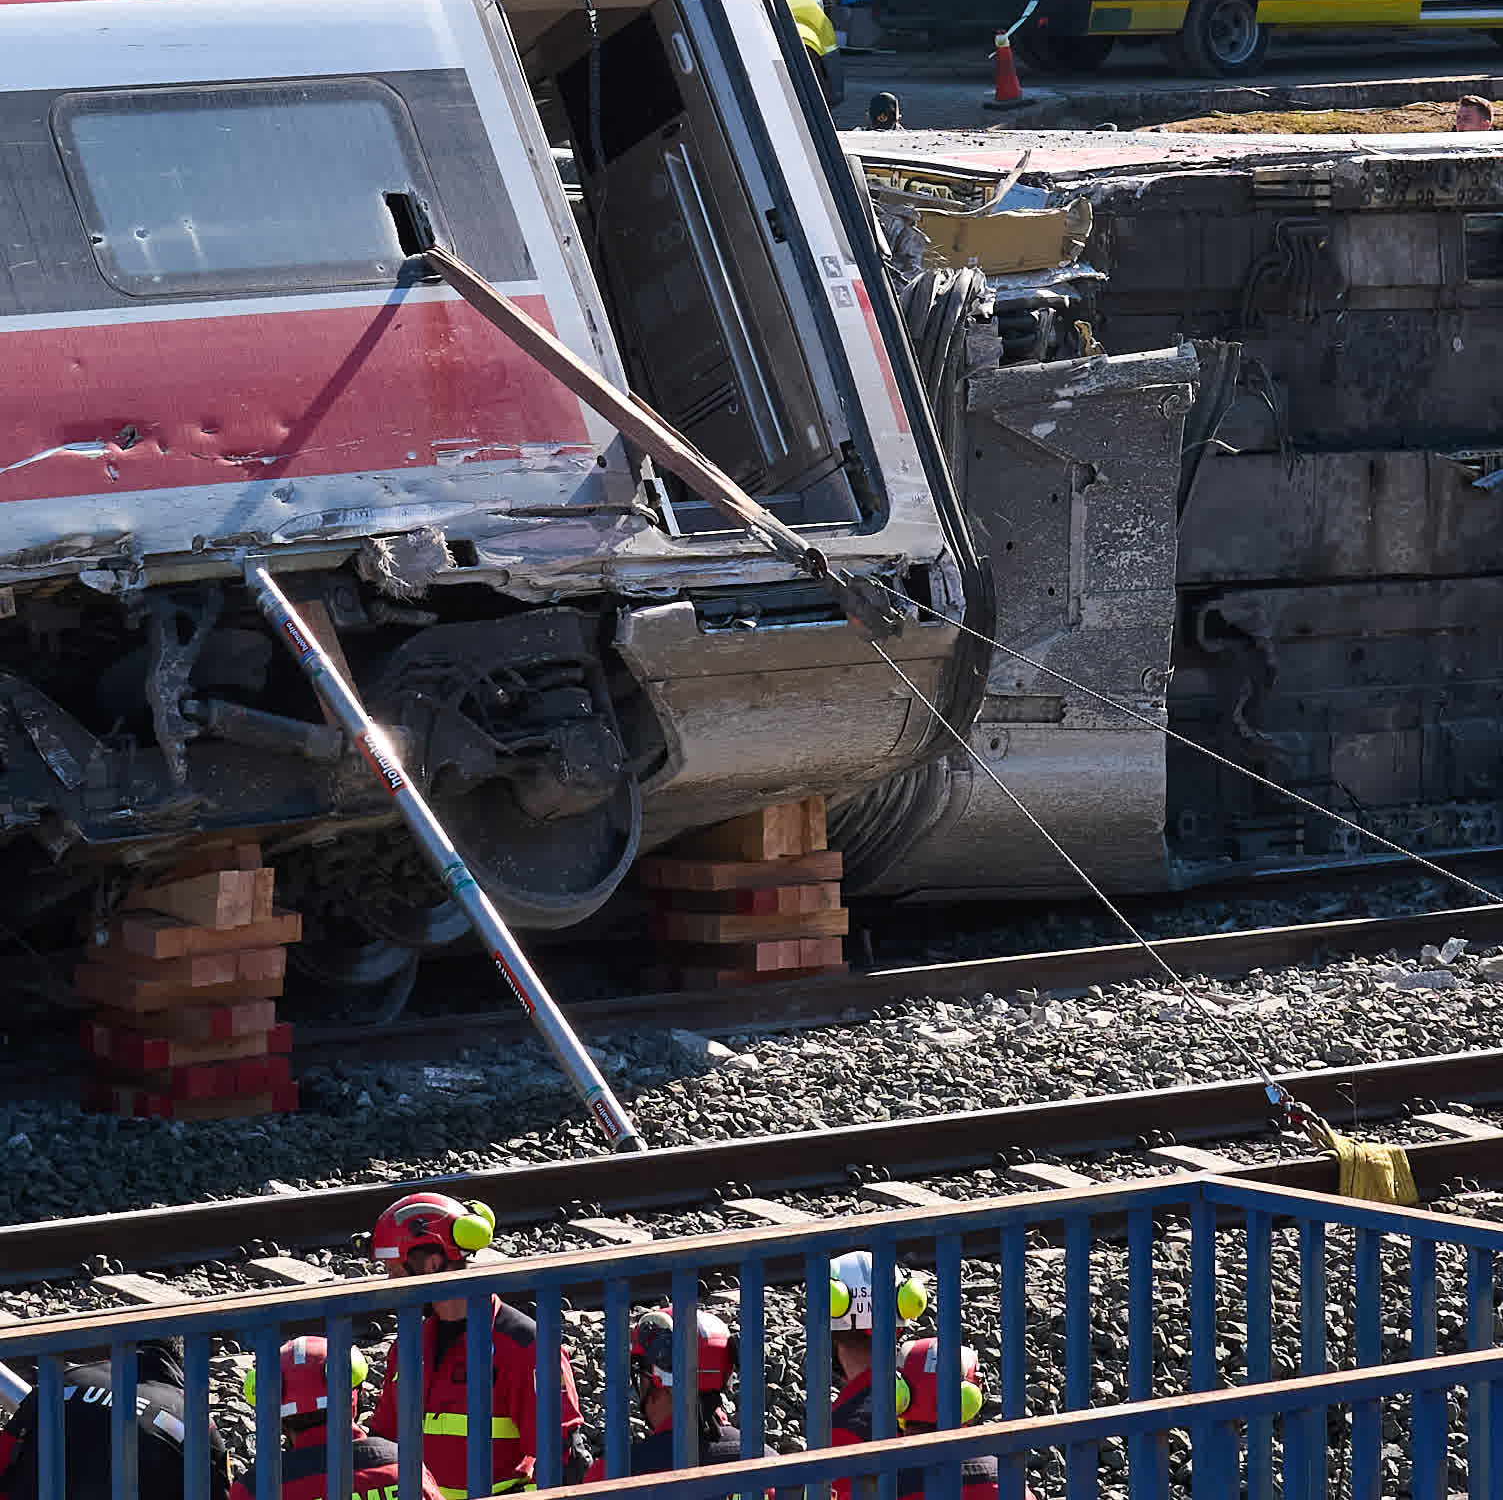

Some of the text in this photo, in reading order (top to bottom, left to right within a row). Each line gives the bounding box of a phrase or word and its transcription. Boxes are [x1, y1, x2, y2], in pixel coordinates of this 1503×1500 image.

[286, 622, 309, 652] holmatro
[364, 732, 402, 789] holmatro
[596, 1102, 618, 1136] holmatro
